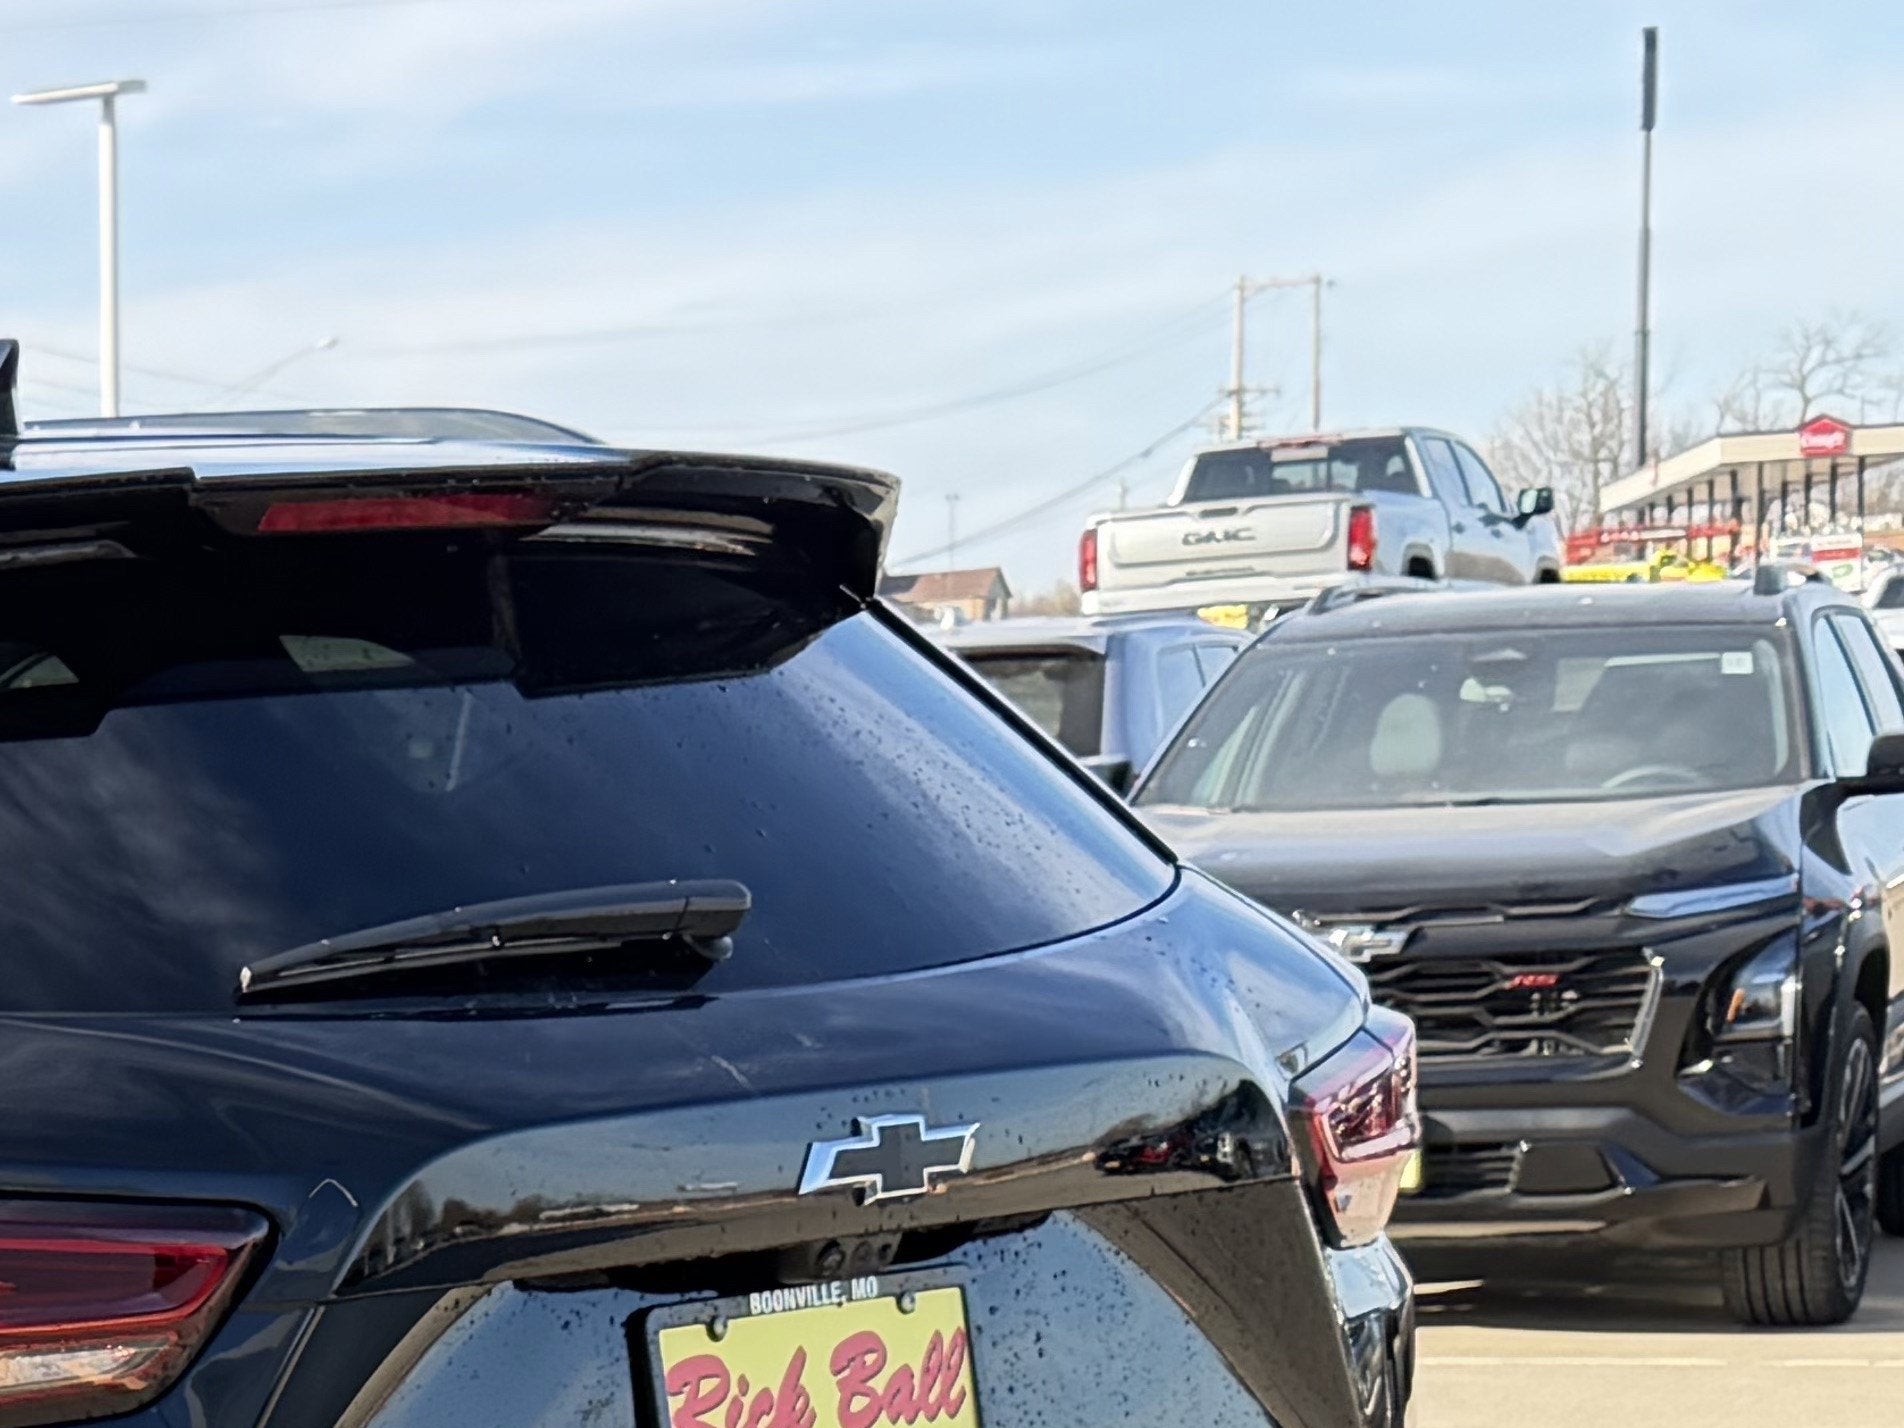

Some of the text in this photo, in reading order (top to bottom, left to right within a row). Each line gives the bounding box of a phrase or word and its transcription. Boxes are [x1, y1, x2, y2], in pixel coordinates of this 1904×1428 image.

[1182, 527, 1256, 546] GMC
[749, 1275, 878, 1315] BOONVILLE, MO
